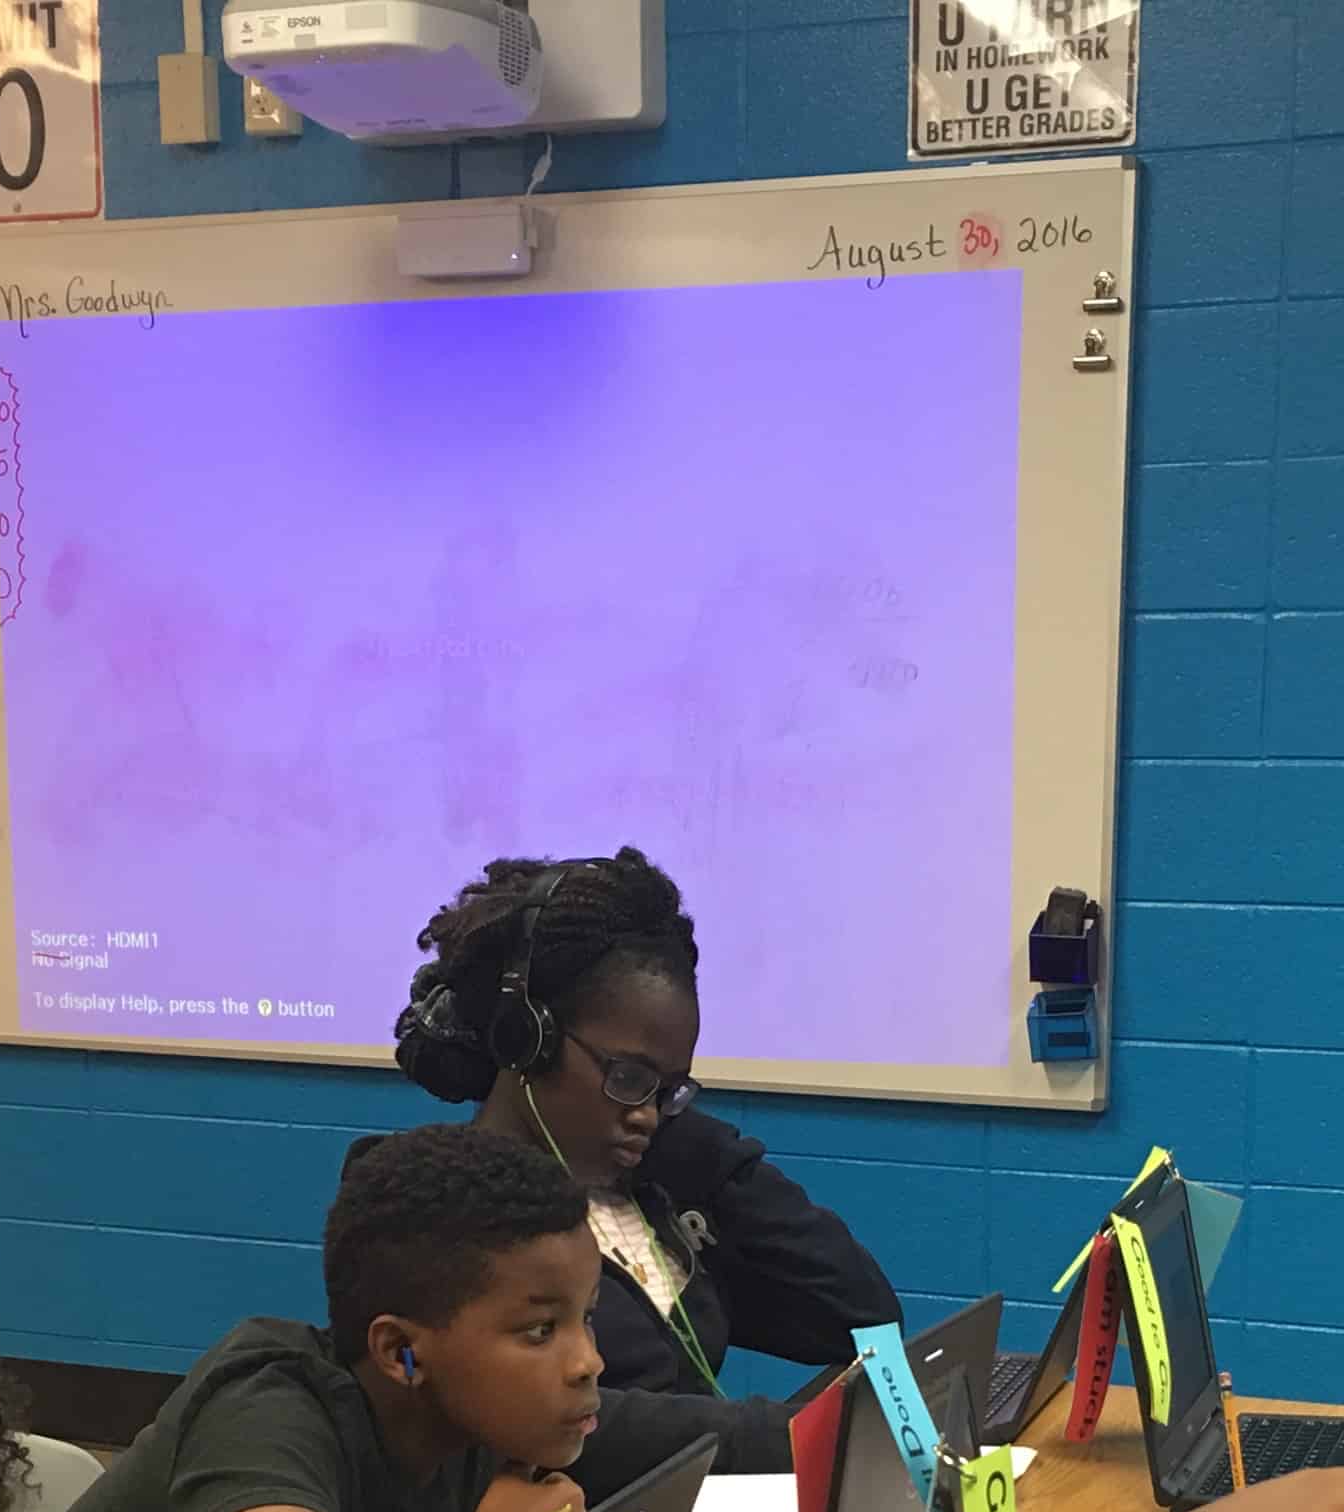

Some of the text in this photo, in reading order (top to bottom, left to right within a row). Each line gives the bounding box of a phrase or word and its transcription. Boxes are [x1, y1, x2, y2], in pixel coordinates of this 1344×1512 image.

[287, 16, 321, 28] EPSON
[939, 3, 965, 46] U
[936, 49, 957, 72] IN
[966, 72, 1071, 114] U GET
[926, 108, 1115, 144] BETTER GRADES
[807, 225, 947, 289] August
[1017, 216, 1093, 252] 2016
[65, 276, 174, 330] Goodwyn
[31, 930, 159, 949] Source: HDMI1
[59, 952, 109, 970] Signal
[33, 992, 54, 1009] To
[59, 993, 116, 1014] display
[121, 994, 164, 1015] Help,
[169, 999, 216, 1017] press
[222, 997, 249, 1016] the
[278, 1000, 335, 1018] button
[1131, 1237, 1155, 1315] Good
[882, 1366, 924, 1458] Done
